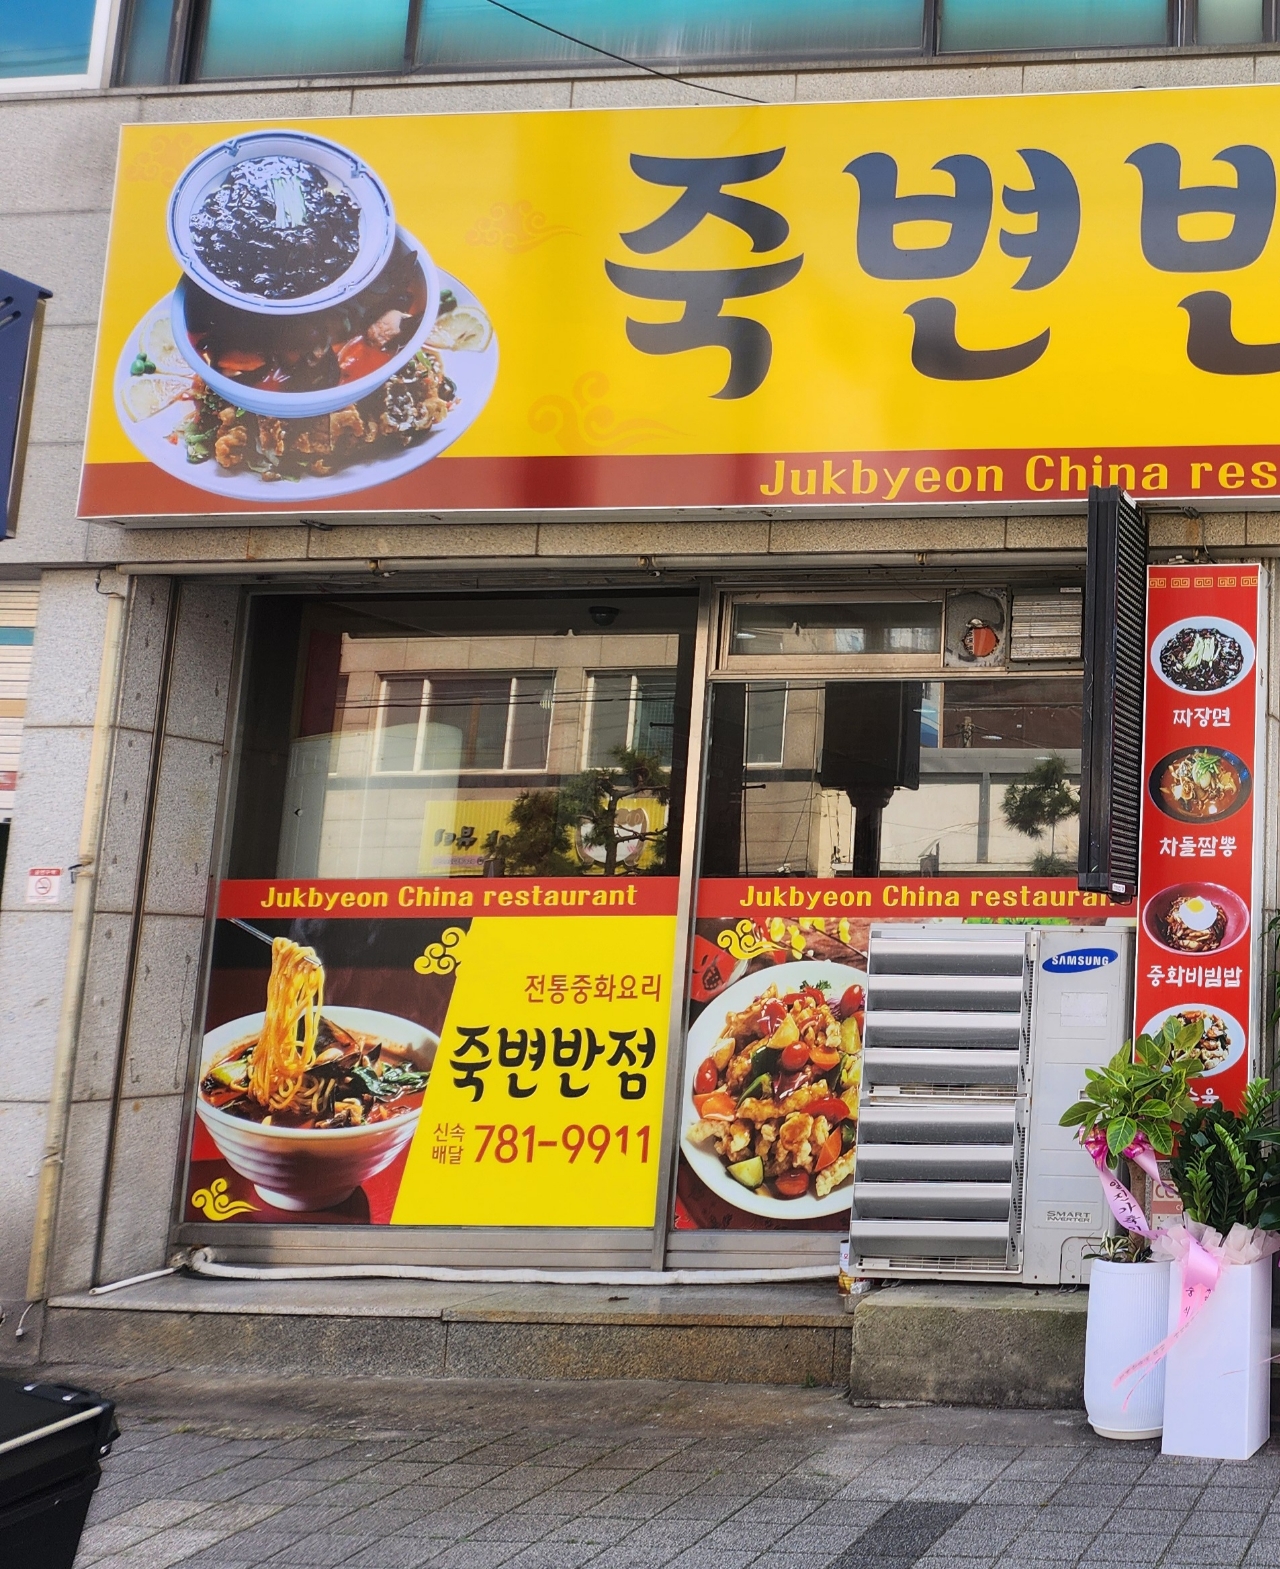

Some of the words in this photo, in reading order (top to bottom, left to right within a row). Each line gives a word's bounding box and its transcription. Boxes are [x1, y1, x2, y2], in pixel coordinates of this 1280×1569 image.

[759, 458, 1004, 500] Jukbyeon
[1025, 453, 1169, 493] China
[1172, 706, 1231, 728] 짜장면
[1159, 835, 1238, 858] 차돌짬뽕
[260, 887, 388, 911] Jukbyeon
[398, 885, 474, 907] China
[483, 884, 637, 907] restaurant
[739, 885, 872, 911] Jukbyeon
[882, 885, 960, 907] China
[970, 885, 1115, 907] restaura
[1051, 955, 1110, 967] SAMSUNG
[1146, 965, 1243, 988] 중화비빔밥
[524, 973, 662, 1005] 전통중화요리
[449, 1024, 657, 1103] 죽변반점
[433, 1122, 466, 1143] 신속
[474, 1123, 651, 1165] 781-9911
[431, 1145, 464, 1165] 배달
[1046, 1210, 1091, 1218] SMART
